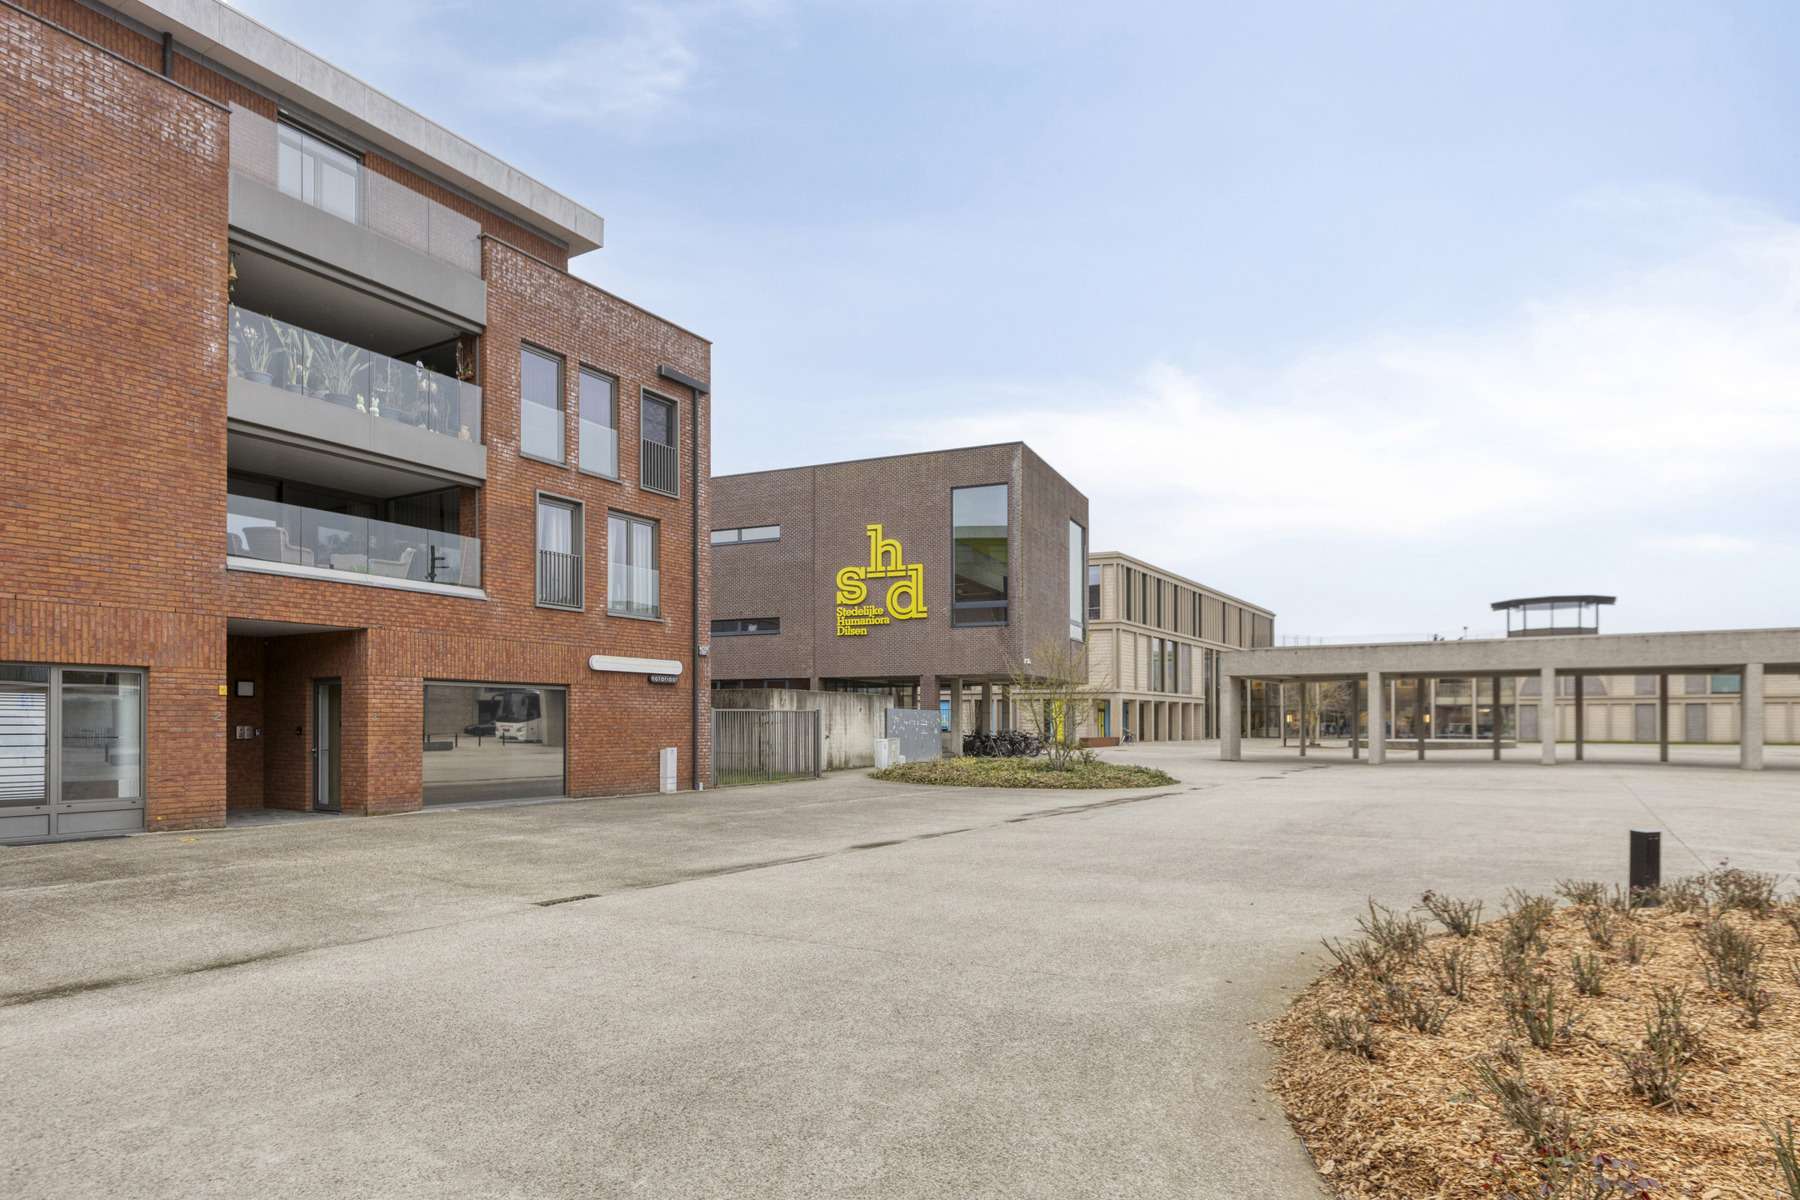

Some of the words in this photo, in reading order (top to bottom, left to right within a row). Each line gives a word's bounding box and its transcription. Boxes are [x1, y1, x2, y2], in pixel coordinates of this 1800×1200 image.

[837, 606, 884, 617] Stedelijke
[837, 616, 890, 626] Humaniora
[837, 626, 867, 636] Dilsen
[214, 712, 221, 720] 2
